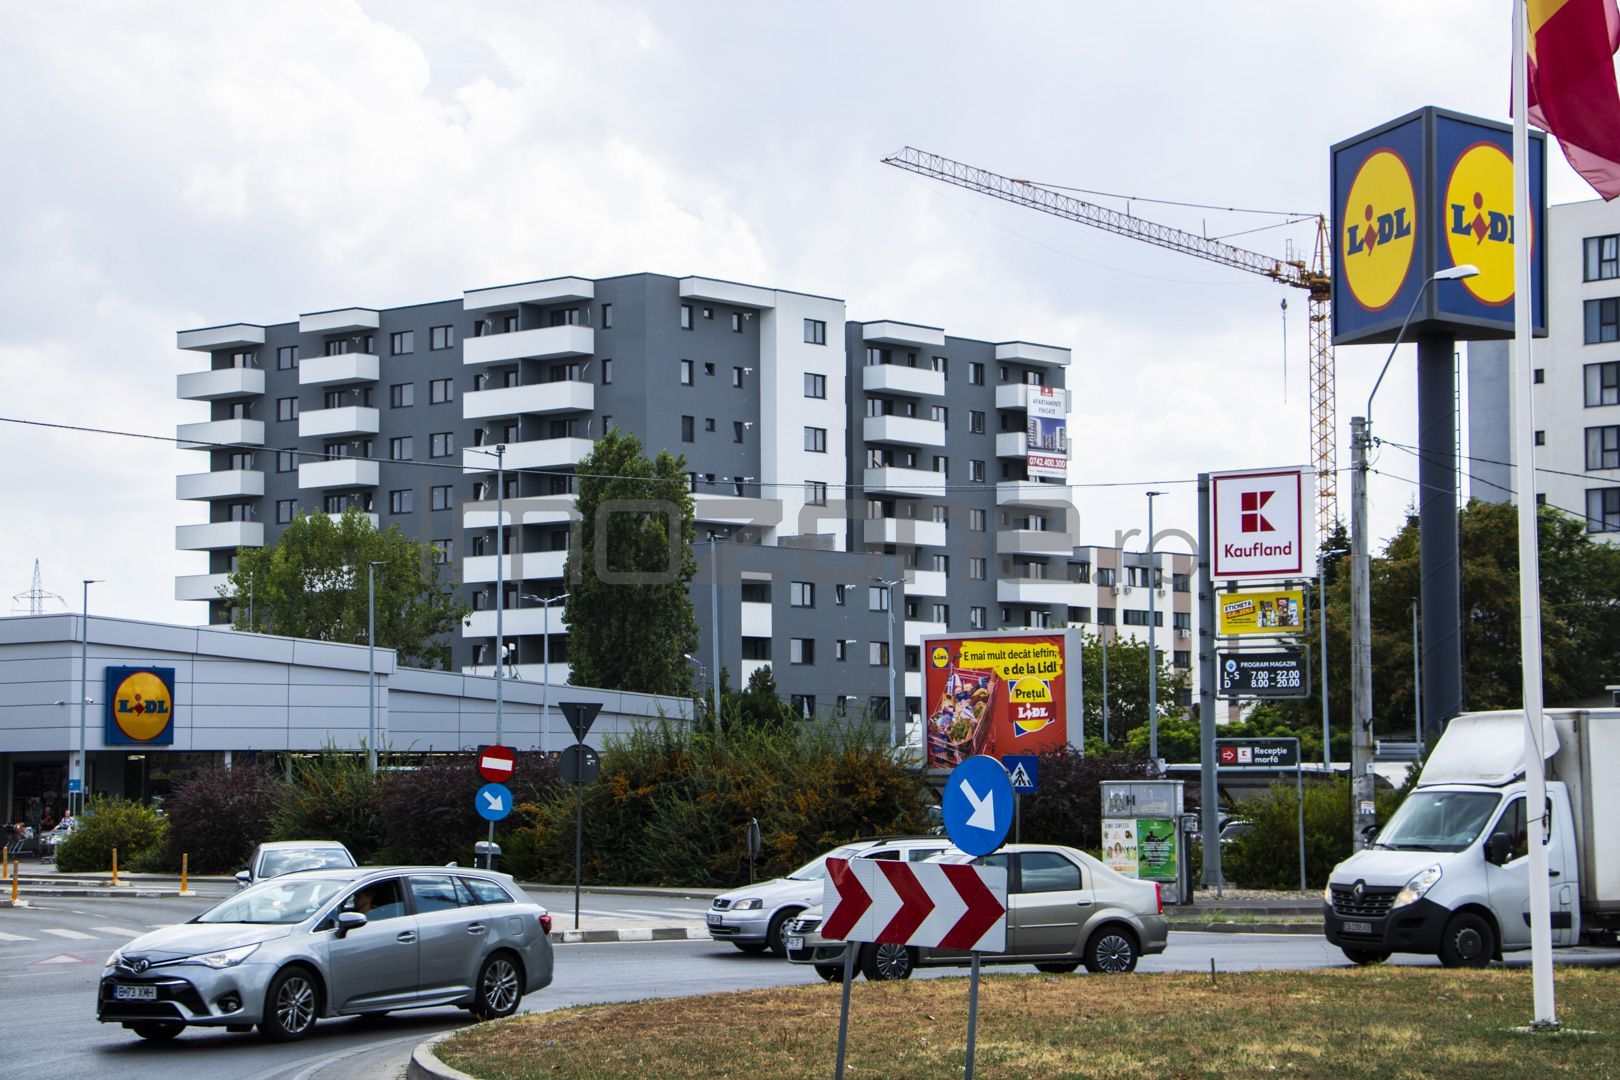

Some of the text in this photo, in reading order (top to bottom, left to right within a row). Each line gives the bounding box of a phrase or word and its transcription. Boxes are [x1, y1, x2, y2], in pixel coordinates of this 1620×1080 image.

[1224, 541, 1291, 558] Kaufland
[964, 651, 969, 661] E
[971, 650, 985, 660] mai
[987, 650, 1006, 660] mult
[1008, 648, 1031, 660] decât
[1003, 662, 1057, 675] e de la Lidl
[1240, 660, 1297, 668] PROGRAM MAGAZIN
[1251, 670, 1269, 679] 7.00
[1276, 670, 1300, 679] 22.00
[1224, 680, 1231, 688] D
[1251, 679, 1269, 688] 8.00
[1276, 678, 1300, 688] 20.00
[1015, 688, 1045, 701] Prețul
[1254, 746, 1288, 756] Recepție
